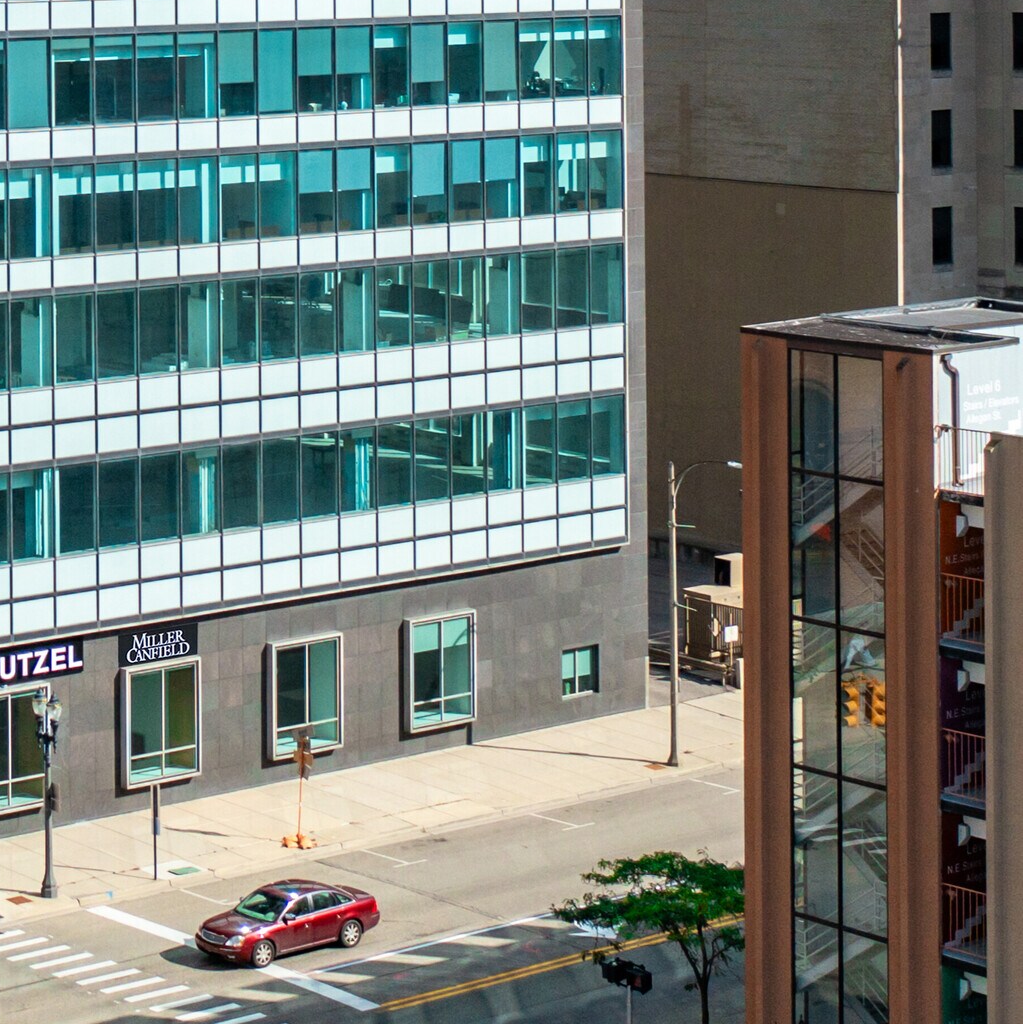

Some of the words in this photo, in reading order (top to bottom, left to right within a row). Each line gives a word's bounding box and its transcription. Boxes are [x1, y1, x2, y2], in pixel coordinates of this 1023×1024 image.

[967, 380, 993, 396] Level
[994, 379, 1001, 393] 6
[132, 629, 185, 650] MILLER
[126, 641, 191, 663] CANFIELD
